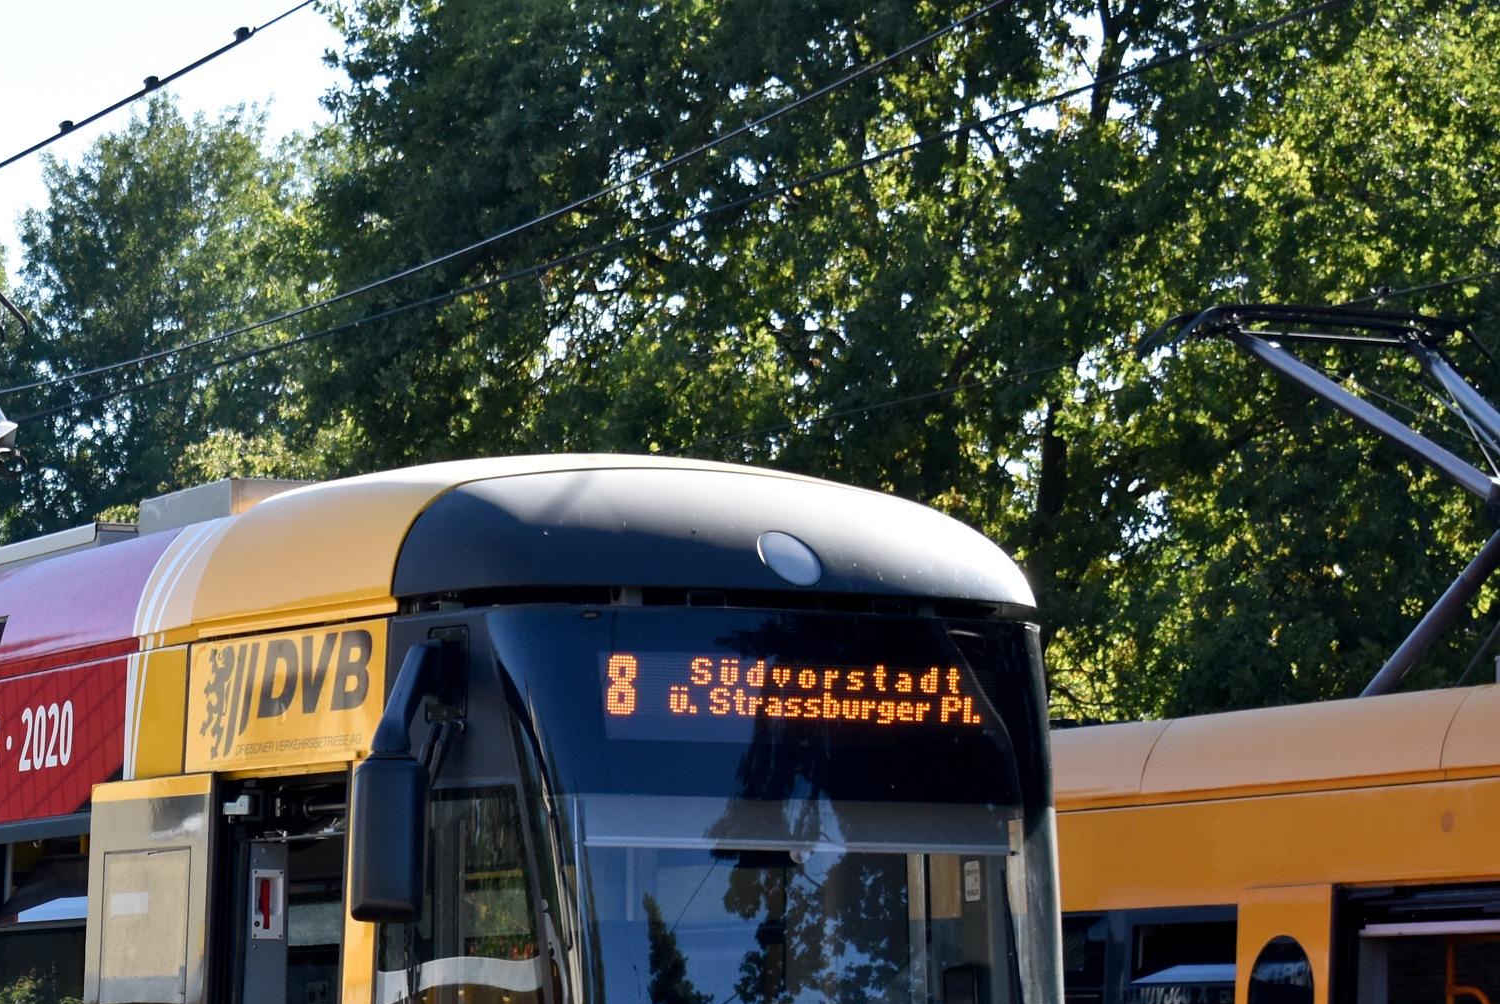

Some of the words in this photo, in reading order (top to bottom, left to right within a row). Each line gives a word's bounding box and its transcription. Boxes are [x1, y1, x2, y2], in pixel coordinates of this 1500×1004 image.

[257, 629, 373, 719] DVB
[607, 654, 637, 716] 8
[669, 685, 698, 714] ü.
[709, 687, 930, 724] Strassburger
[941, 695, 981, 724] Pl.
[690, 657, 960, 694] Südvorstadt
[18, 700, 74, 773] 2020
